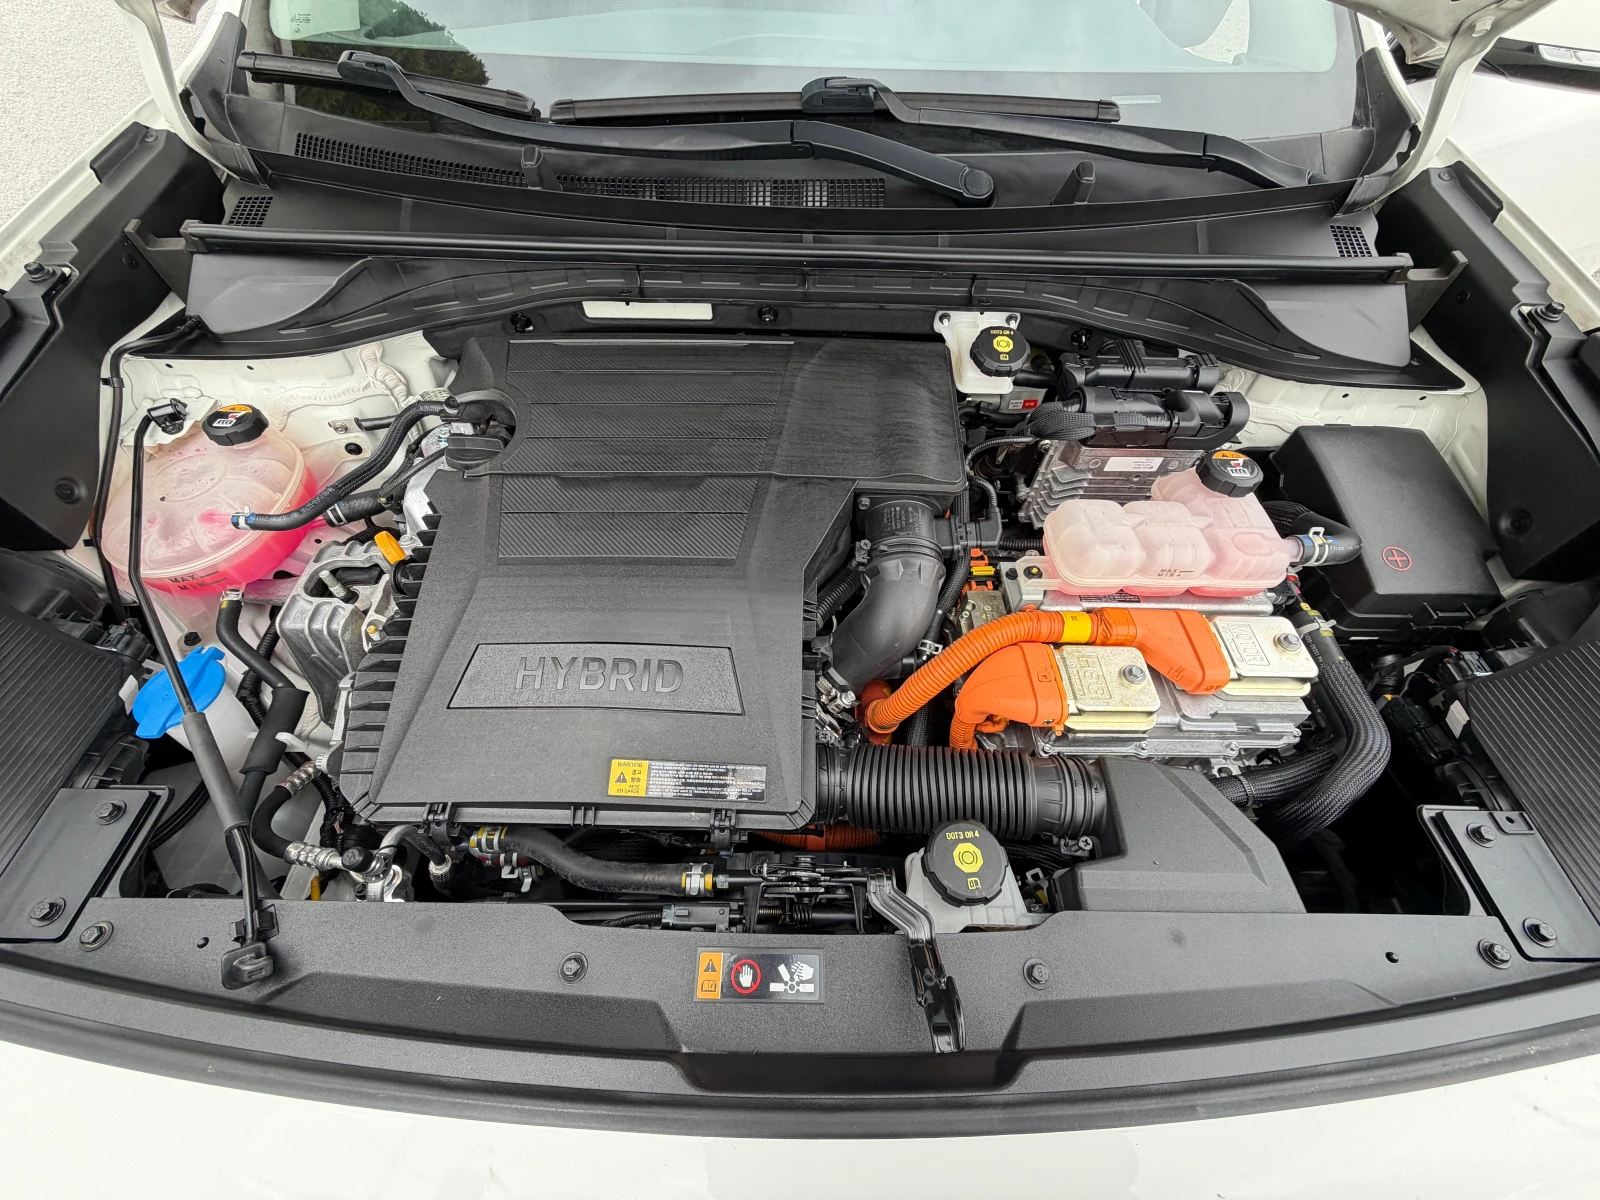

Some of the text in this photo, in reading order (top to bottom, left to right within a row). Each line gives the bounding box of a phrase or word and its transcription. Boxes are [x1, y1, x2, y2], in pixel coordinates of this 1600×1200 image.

[168, 575, 198, 583] MAX
[515, 656, 683, 693] HYBRID
[1077, 656, 1105, 696] HSG
[946, 829, 980, 840] DOT3 OR 4
